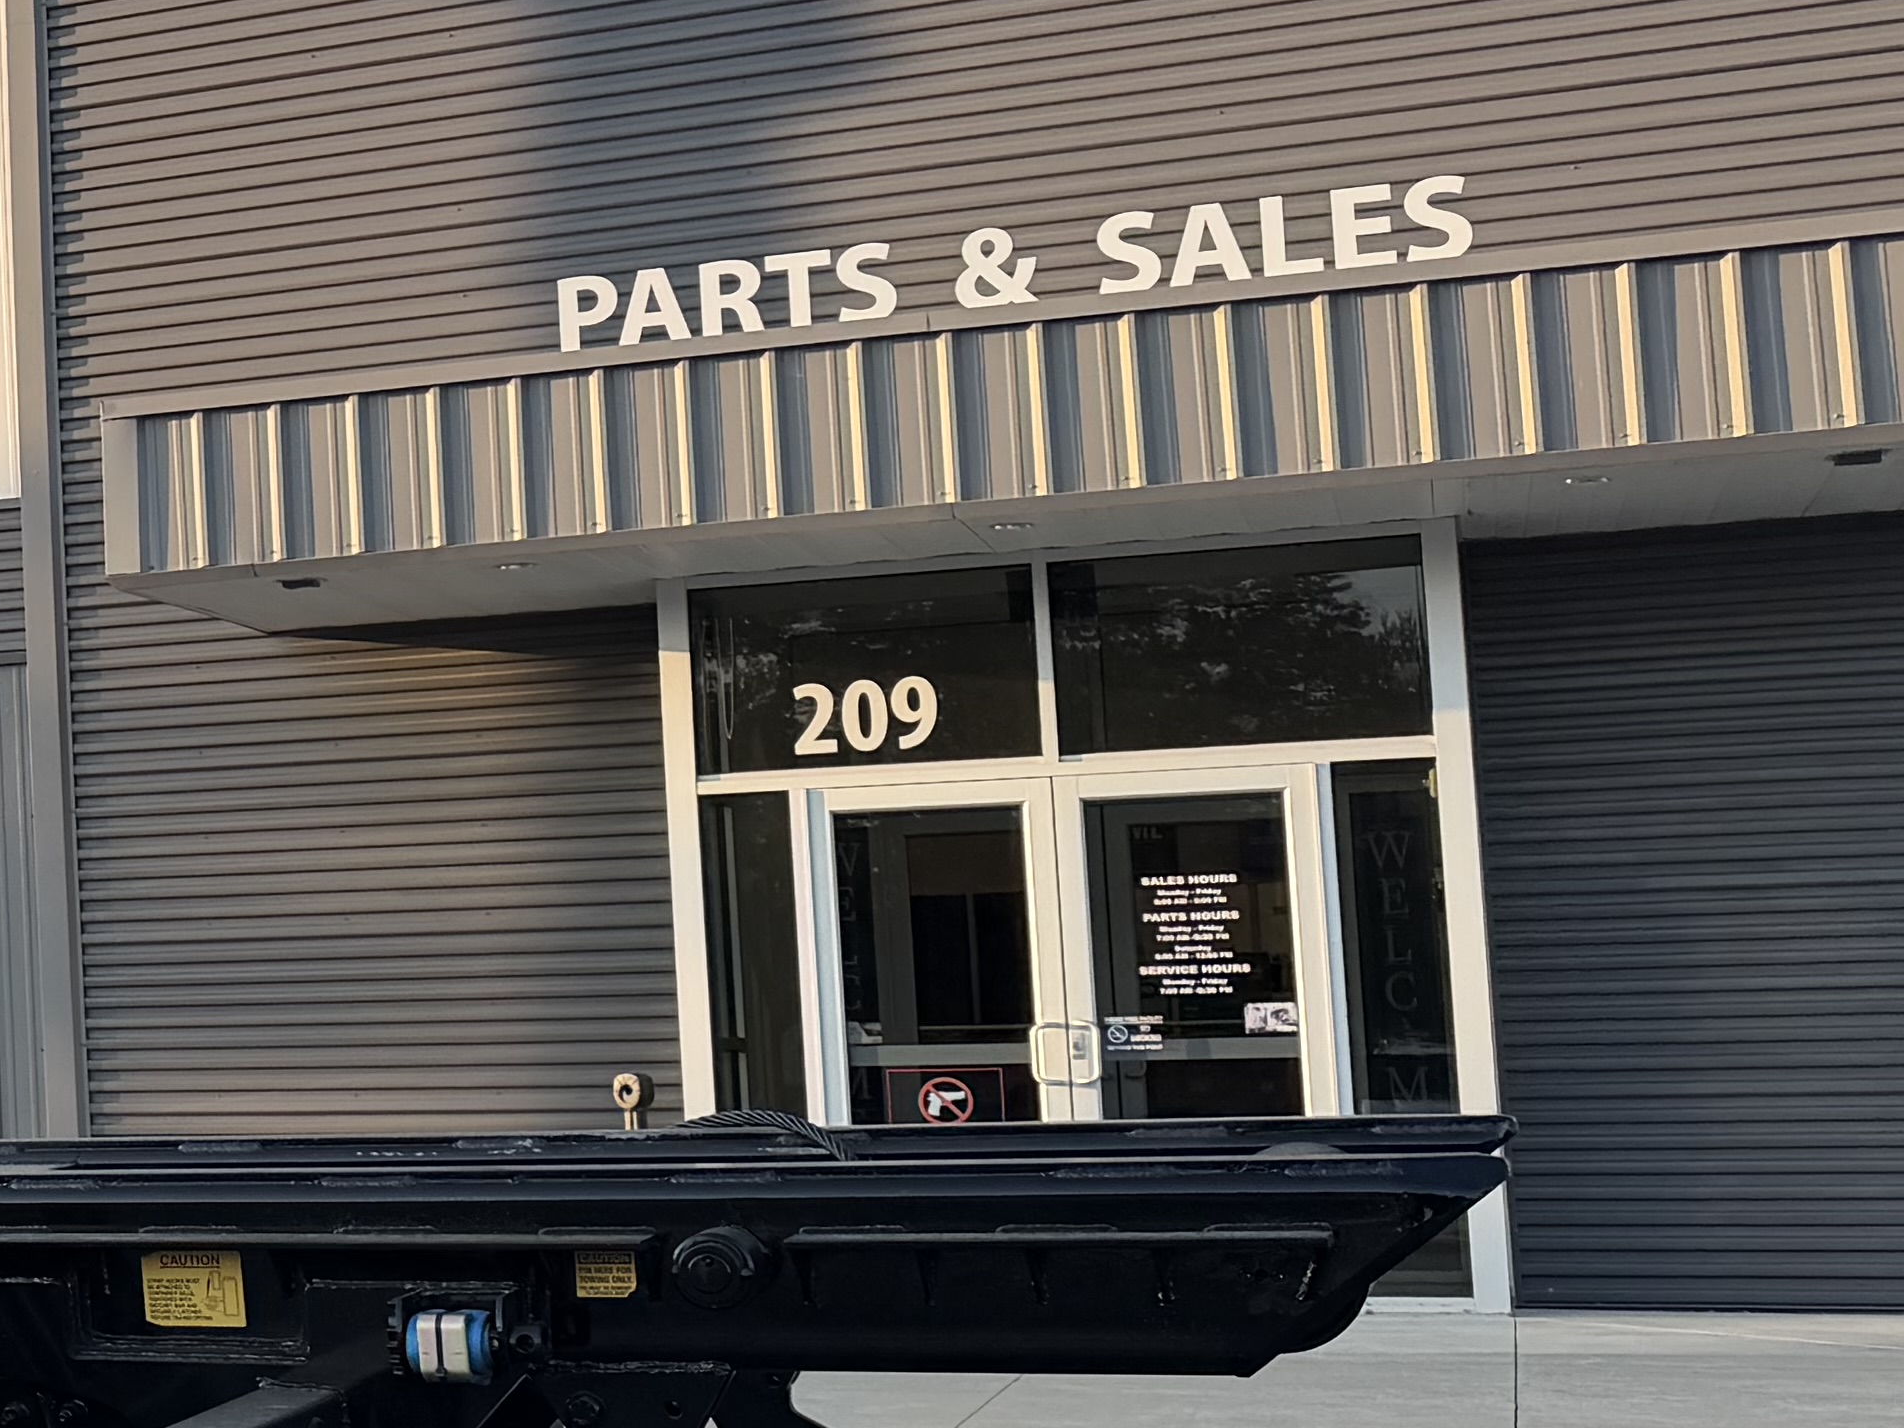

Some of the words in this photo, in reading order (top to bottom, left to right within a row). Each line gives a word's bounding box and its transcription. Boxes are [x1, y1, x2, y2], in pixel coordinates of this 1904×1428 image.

[557, 241, 898, 353] PARTS
[954, 226, 1039, 309] &
[1096, 174, 1475, 296] SALES
[793, 675, 939, 756] 209
[1140, 875, 1185, 886] SALES
[1188, 873, 1238, 884] HOURS
[1142, 912, 1187, 922] PARTS
[1190, 910, 1240, 920] HOURS
[1139, 965, 1198, 975] SERVICE
[1201, 963, 1251, 973] HOURS
[159, 1253, 220, 1265] CAUTION
